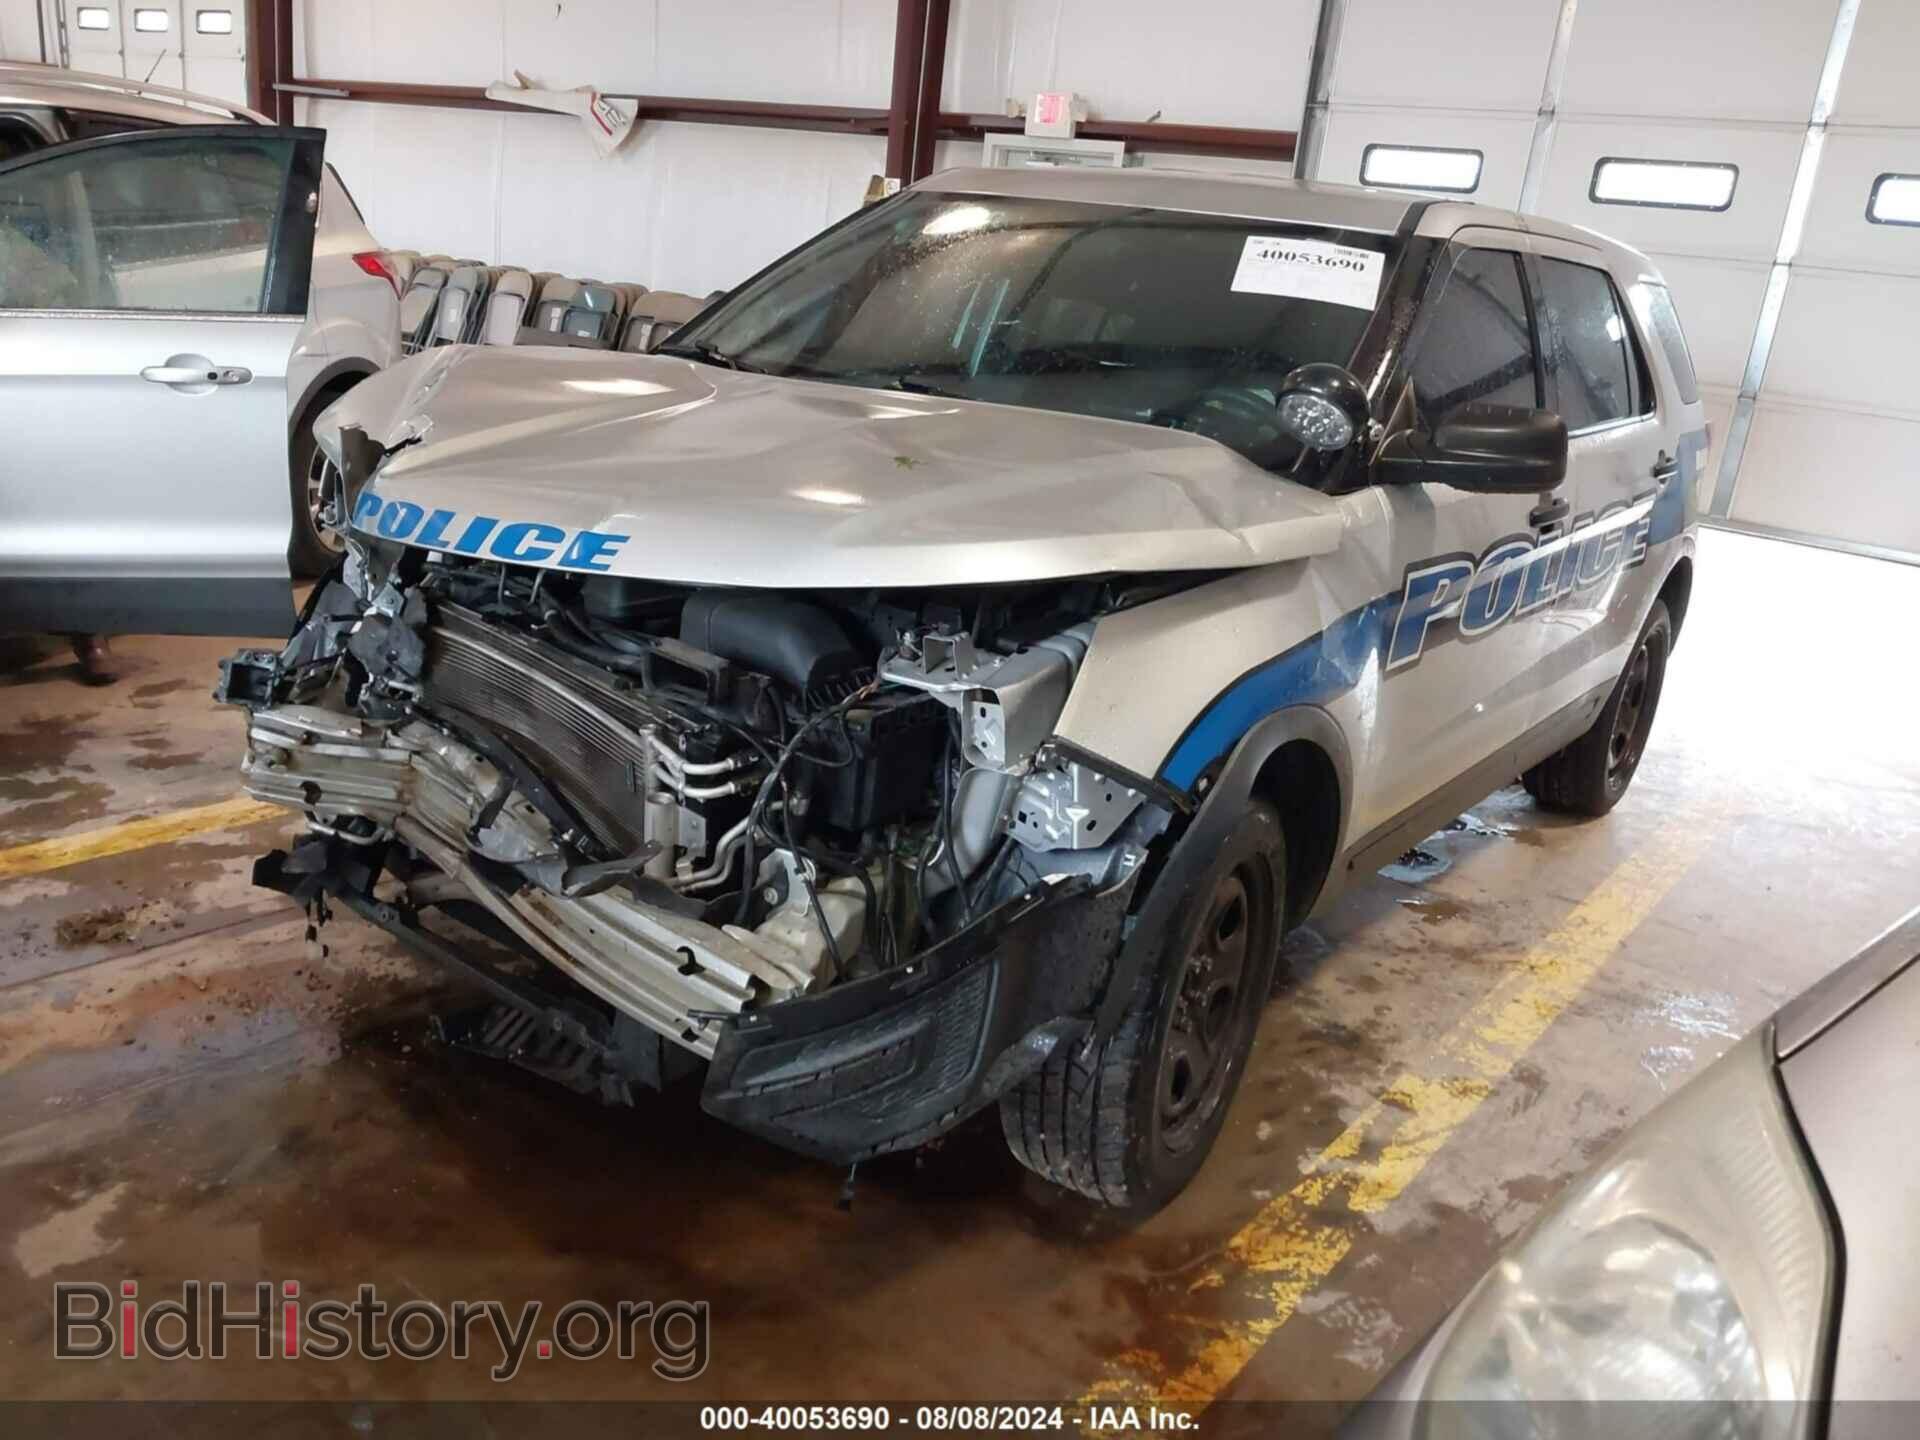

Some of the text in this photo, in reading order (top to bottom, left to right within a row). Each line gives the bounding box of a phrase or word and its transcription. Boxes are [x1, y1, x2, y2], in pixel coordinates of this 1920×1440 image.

[1257, 249, 1366, 272] 40053690
[352, 491, 631, 572] POLICE
[1384, 488, 1657, 677] POLICE
